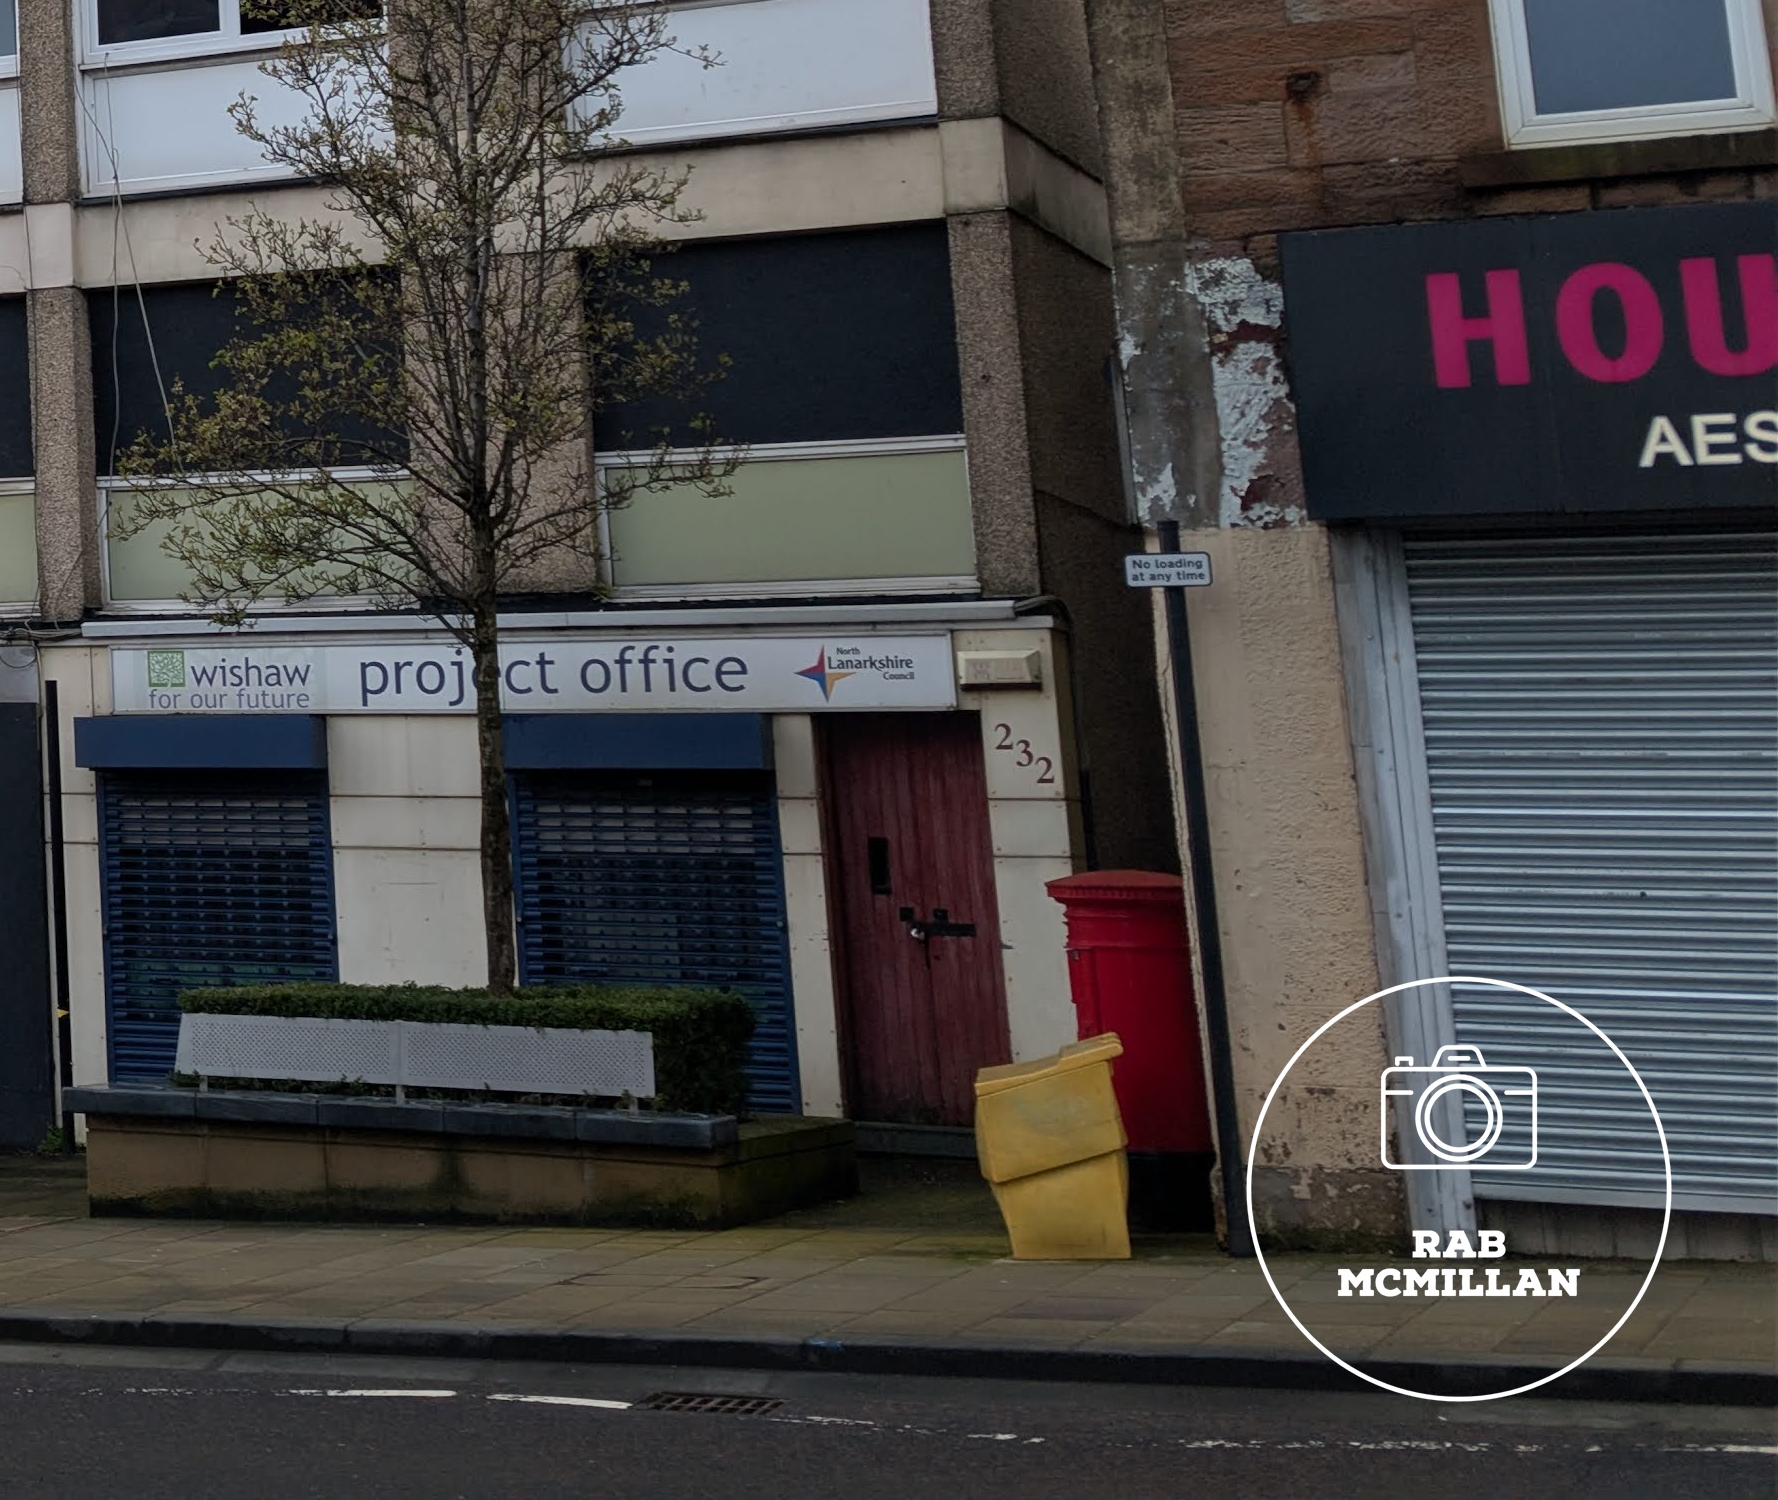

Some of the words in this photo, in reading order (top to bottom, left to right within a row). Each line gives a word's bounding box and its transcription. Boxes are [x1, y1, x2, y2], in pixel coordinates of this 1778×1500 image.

[1426, 253, 1778, 388] HOU
[1639, 410, 1778, 468] AES
[1132, 560, 1150, 569] No
[1155, 559, 1203, 569] loading
[1132, 572, 1145, 581] at
[1149, 573, 1172, 582] any
[1176, 571, 1205, 580] time
[836, 647, 860, 655] North
[190, 657, 311, 688] wishaw
[827, 656, 914, 671] Lanarkshire
[359, 648, 558, 707] projct
[579, 644, 750, 694] office
[883, 672, 915, 680] Council
[148, 689, 180, 709] for
[190, 693, 227, 709] our
[236, 688, 310, 708] future
[994, 723, 1054, 784] 232
